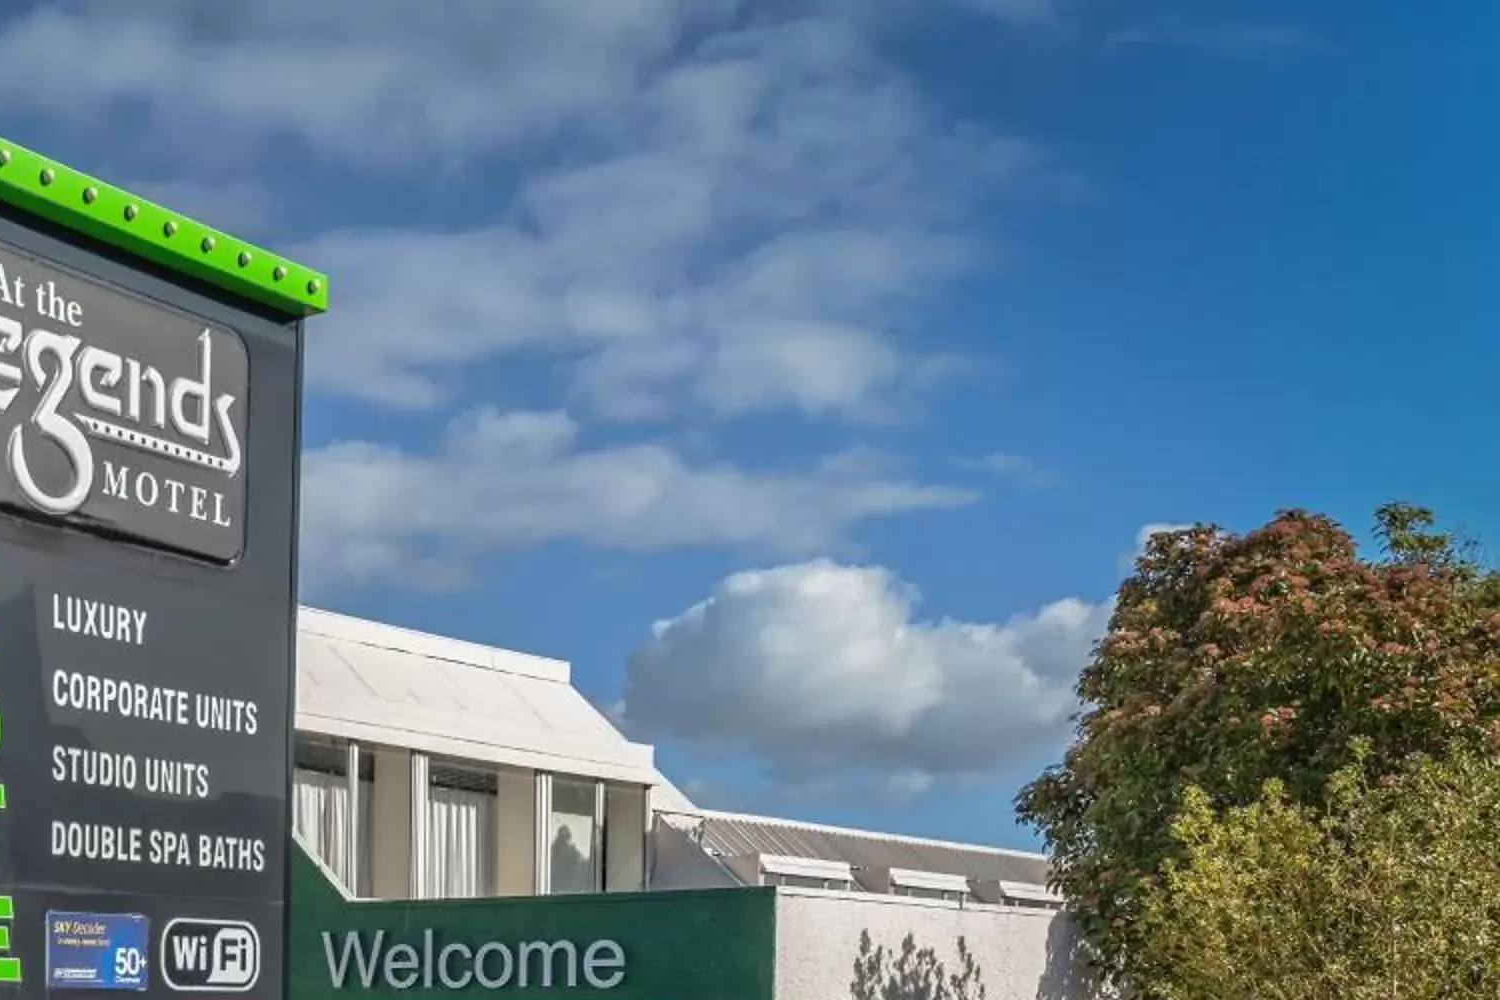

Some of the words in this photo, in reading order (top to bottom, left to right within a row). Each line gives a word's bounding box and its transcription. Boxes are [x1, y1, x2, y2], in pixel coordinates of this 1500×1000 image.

[36, 280, 83, 327] the
[102, 461, 231, 528] MOTEL
[52, 593, 147, 645] LUXURY
[52, 669, 189, 725] CORPORATE
[196, 693, 258, 735] UNITS
[51, 745, 137, 790] STUDIO
[145, 757, 209, 798] UNITS
[51, 820, 142, 862] DOUBLE
[150, 829, 191, 866] SPA
[199, 834, 266, 872] BATHS
[115, 946, 147, 976] 50+
[320, 928, 627, 990] Welcome
